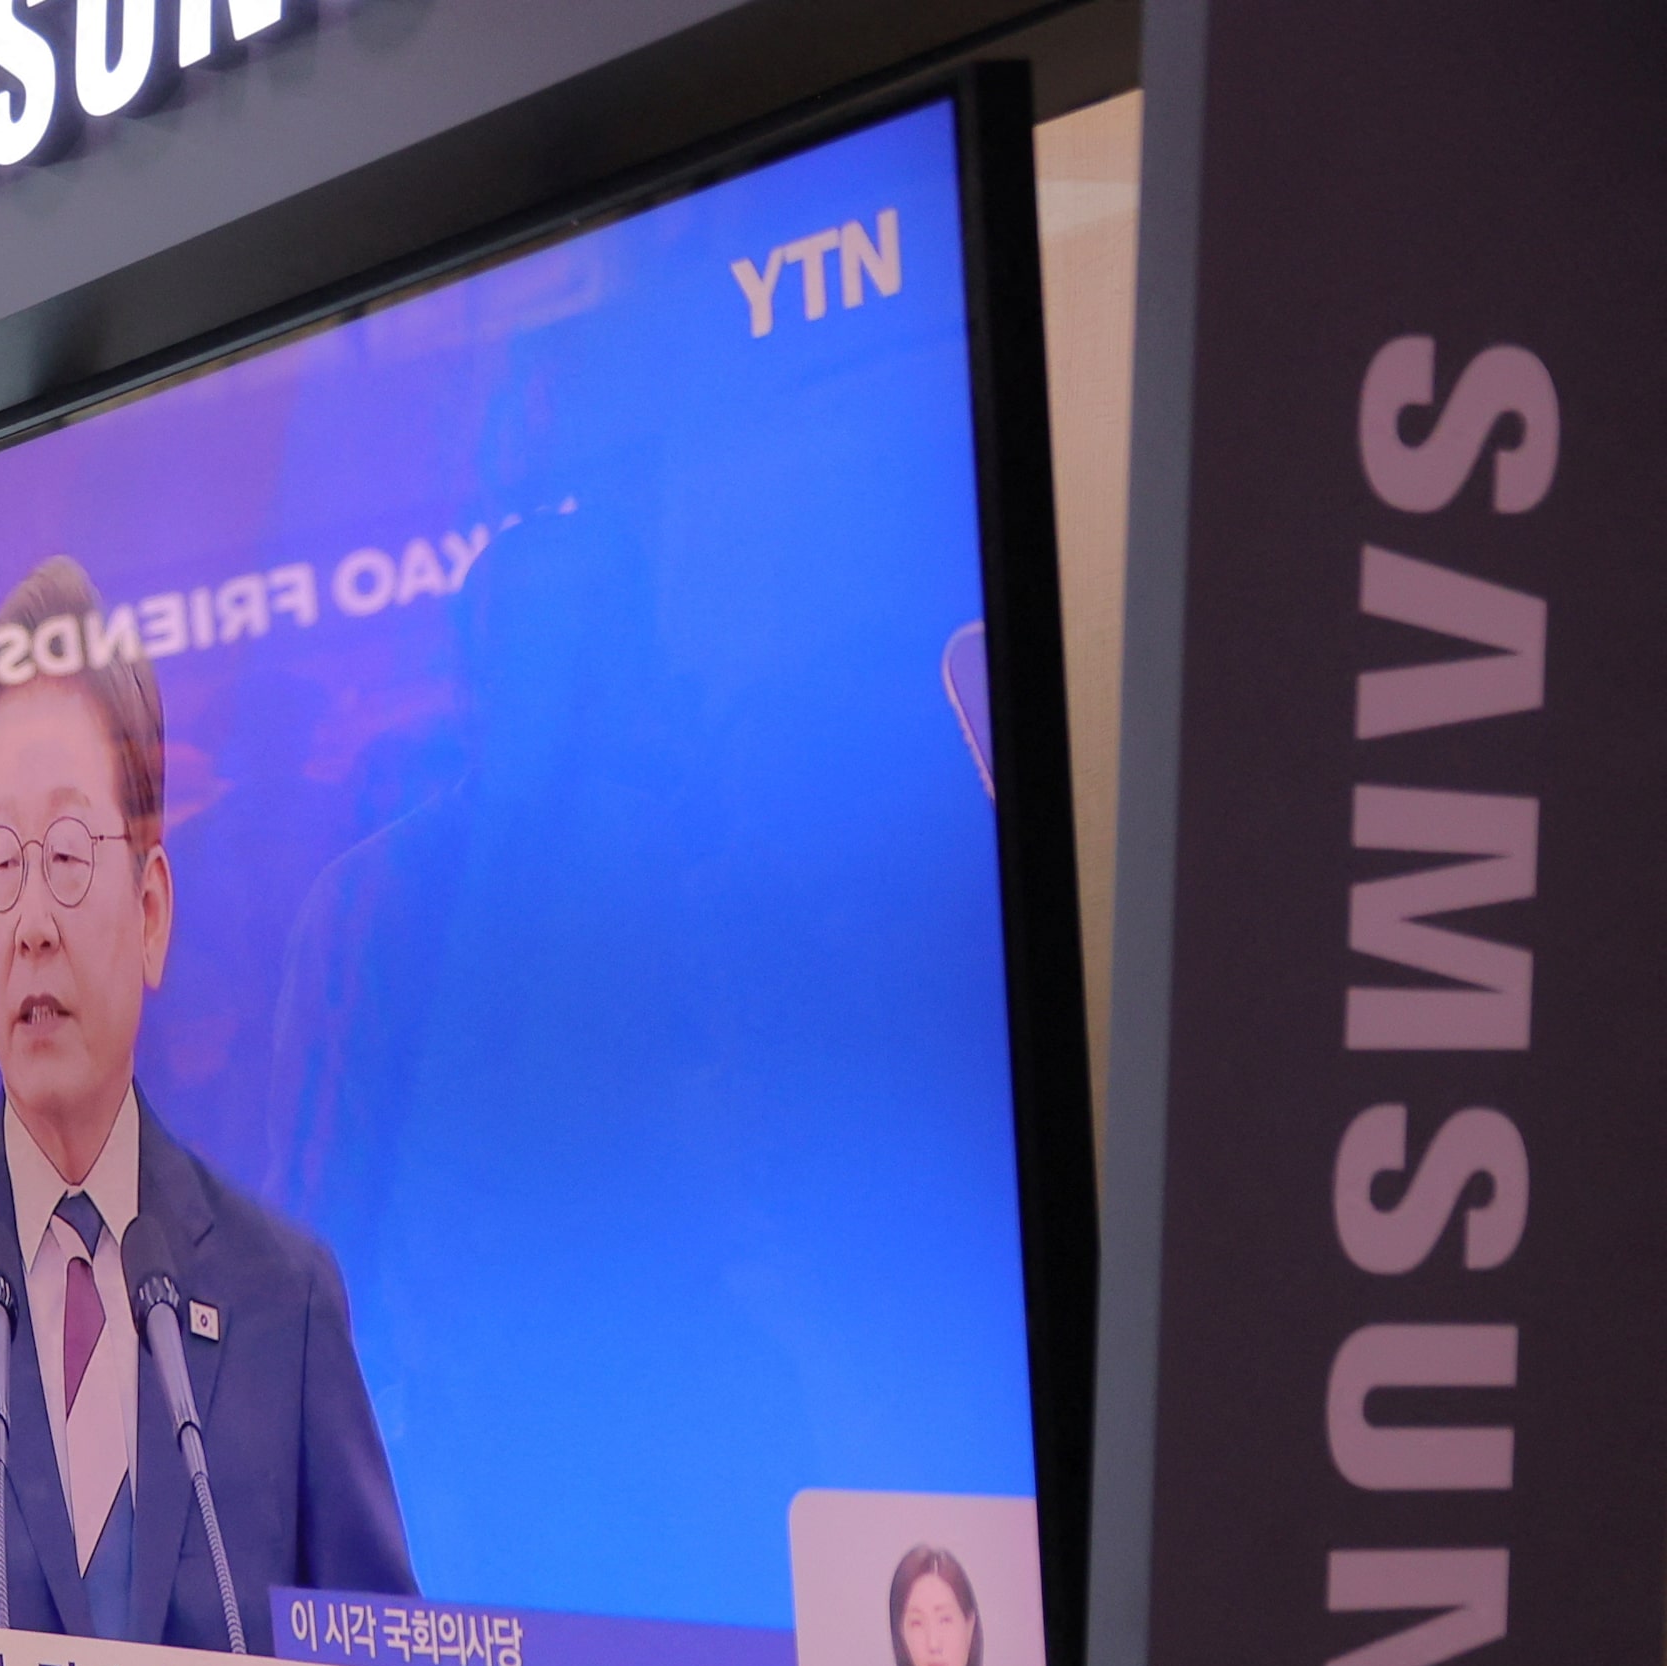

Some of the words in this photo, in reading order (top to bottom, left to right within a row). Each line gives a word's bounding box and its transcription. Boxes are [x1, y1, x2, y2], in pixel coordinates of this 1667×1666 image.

[730, 207, 901, 338] YTN
[291, 1599, 317, 1652] 이
[324, 1602, 377, 1659] 시각
